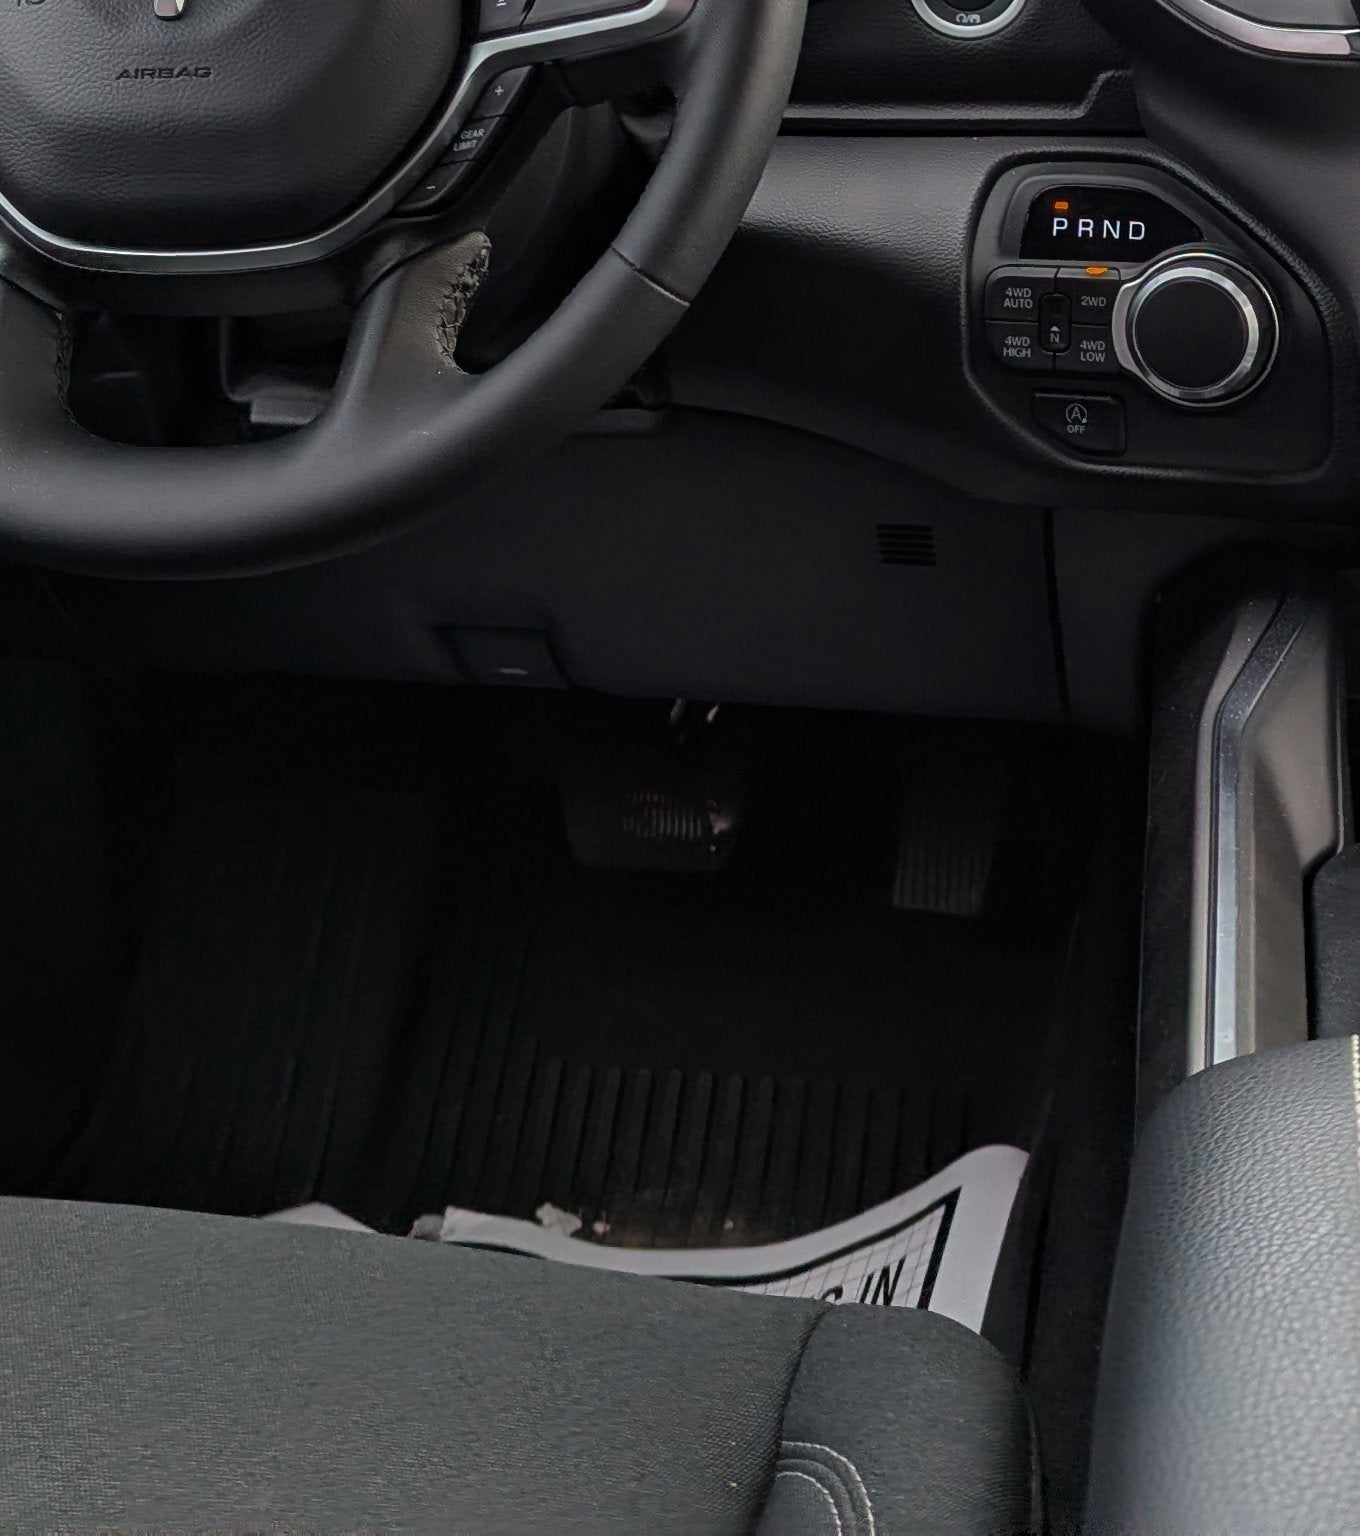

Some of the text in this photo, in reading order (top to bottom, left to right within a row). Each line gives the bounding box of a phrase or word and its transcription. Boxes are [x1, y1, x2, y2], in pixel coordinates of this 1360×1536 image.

[115, 66, 212, 80] AIRBAG
[460, 128, 485, 140] GEAR
[453, 140, 477, 152] LIMIT
[1052, 217, 1146, 241] P R N D
[1005, 287, 1032, 298] 4WD
[1003, 297, 1033, 309] AUTO
[1080, 295, 1107, 307] 2WD
[1004, 336, 1031, 347] 4WD
[1050, 332, 1060, 345] N
[1080, 340, 1106, 351] 4WD
[1003, 347, 1032, 358] HIGH
[1080, 351, 1106, 363] LOW
[1067, 424, 1086, 435] OFF
